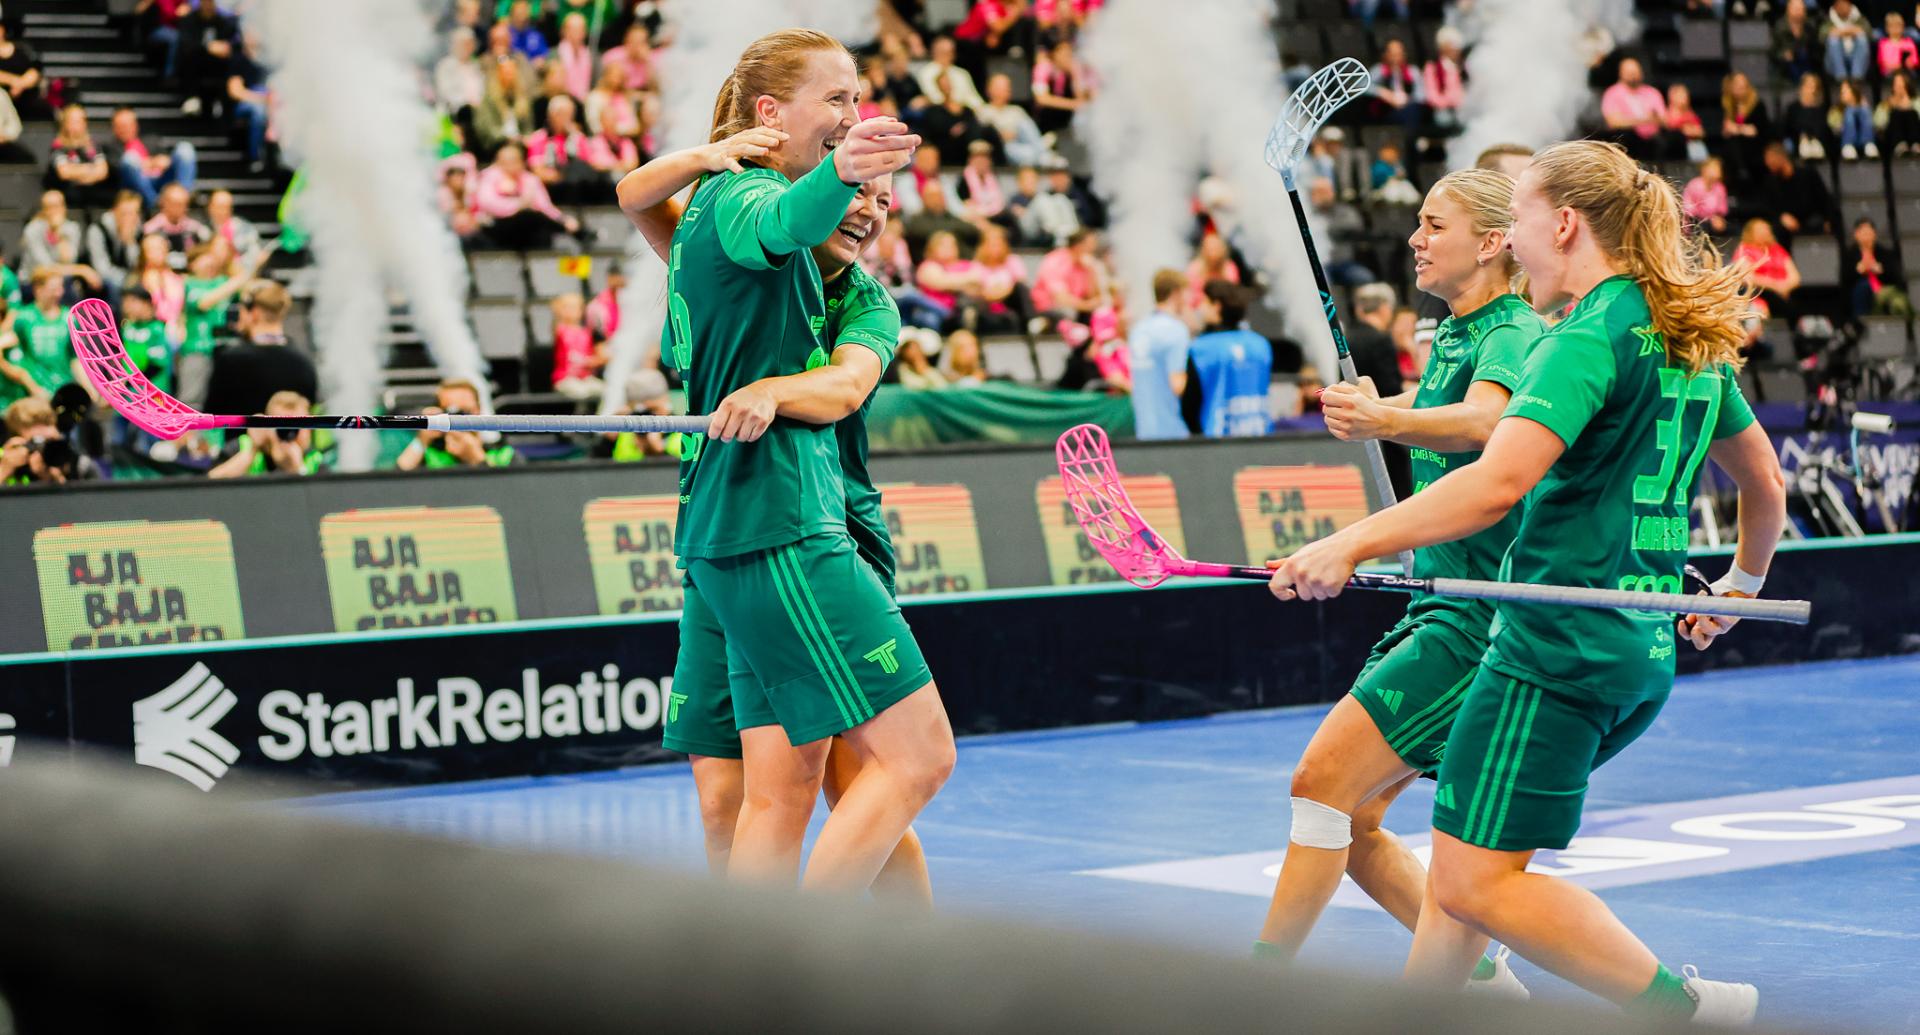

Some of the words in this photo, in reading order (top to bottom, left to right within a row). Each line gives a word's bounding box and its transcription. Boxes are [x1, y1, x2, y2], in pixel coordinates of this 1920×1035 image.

[1633, 367, 1722, 505] 37
[68, 552, 140, 586] AJA
[353, 535, 419, 569] AJA
[85, 588, 187, 630] BAJA
[369, 570, 463, 610] BAJA
